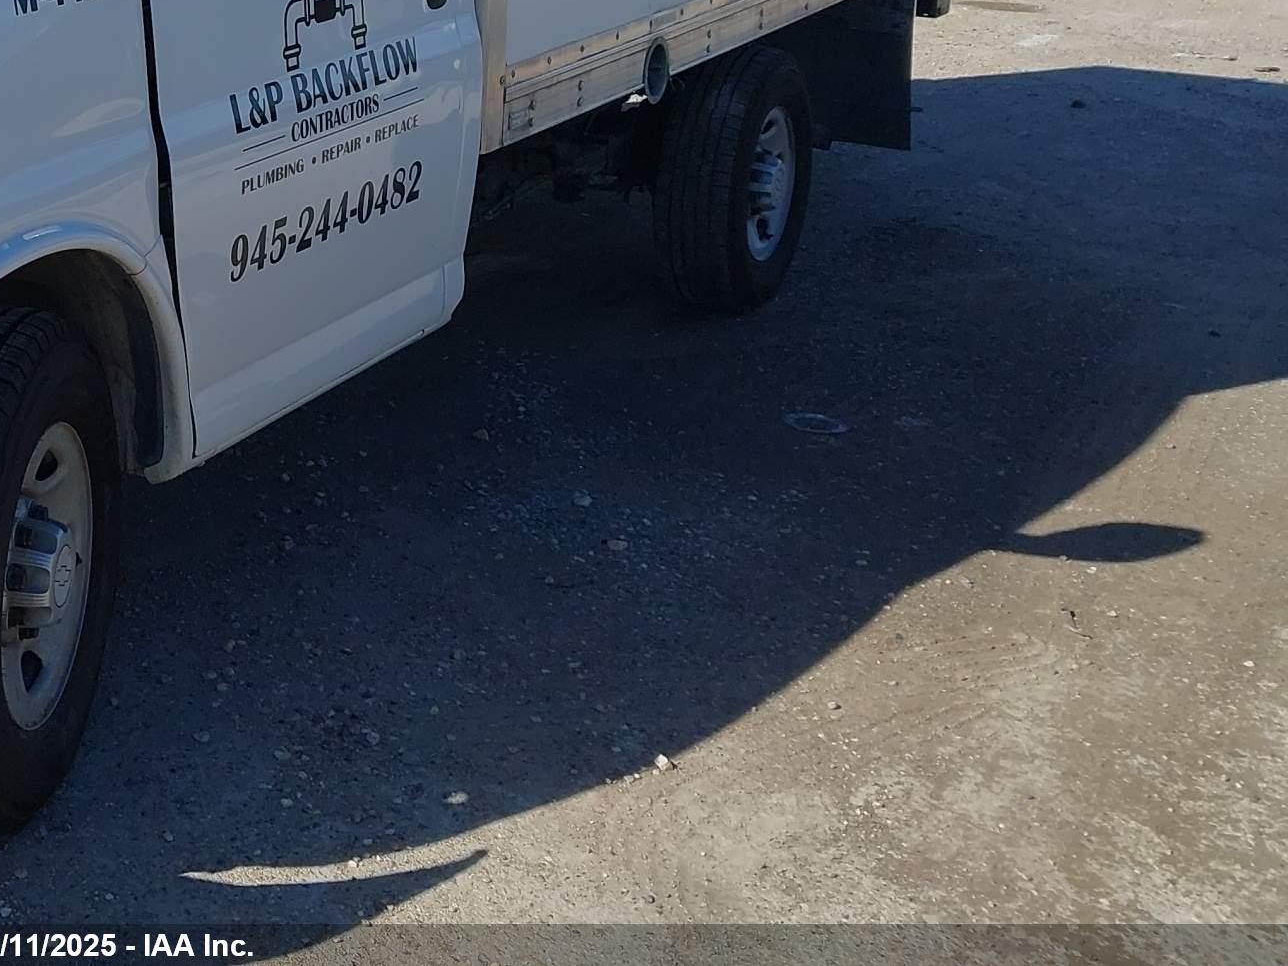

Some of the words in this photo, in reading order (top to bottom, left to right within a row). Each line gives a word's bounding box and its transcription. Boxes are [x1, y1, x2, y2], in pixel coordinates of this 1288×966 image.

[229, 81, 284, 135] L&P
[290, 36, 418, 114] BACKFLOW
[291, 93, 380, 142] CONTRACTORS
[241, 158, 305, 195] PLUMBING
[321, 136, 362, 165] REPAIR
[374, 113, 420, 143] REPLACE
[229, 160, 423, 283] 945-244-0482
